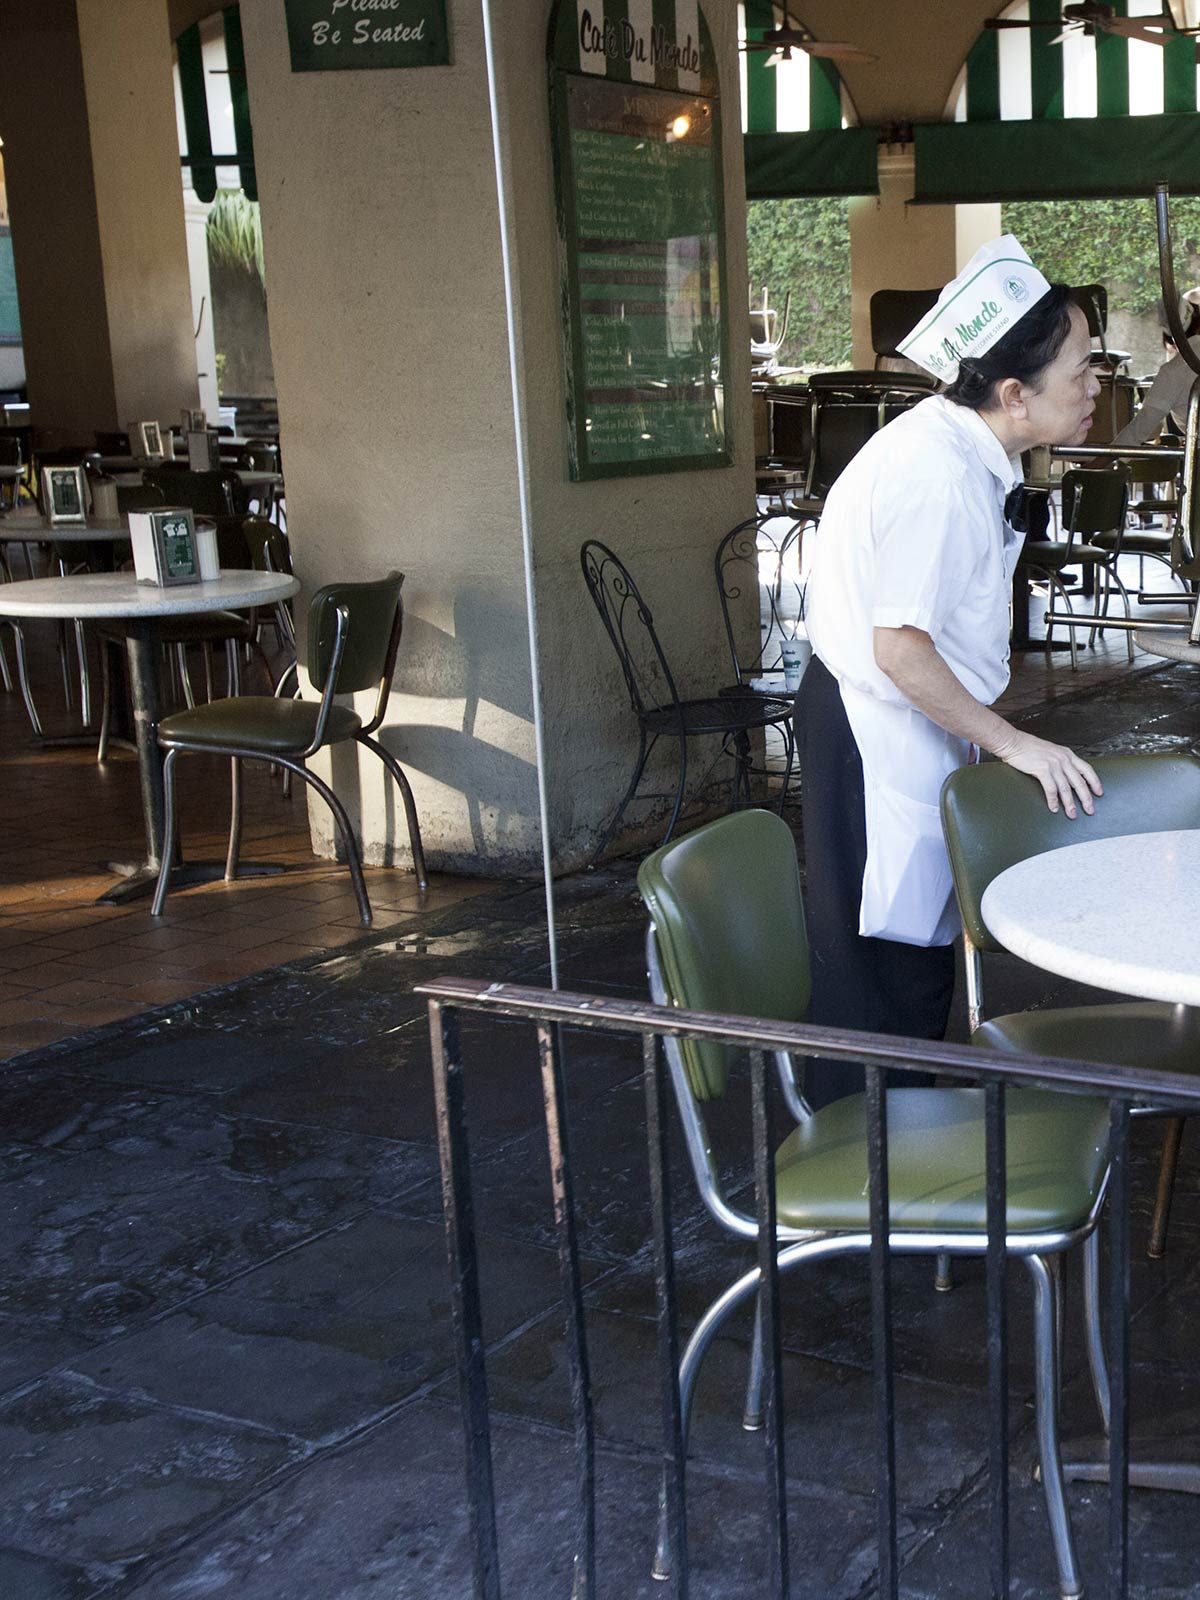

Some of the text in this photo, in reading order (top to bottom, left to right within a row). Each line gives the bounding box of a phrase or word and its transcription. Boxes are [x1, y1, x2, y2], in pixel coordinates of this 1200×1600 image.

[311, 18, 426, 46] Be Seated
[580, 9, 701, 74] Café Du Monde
[955, 300, 1003, 346] Monde
